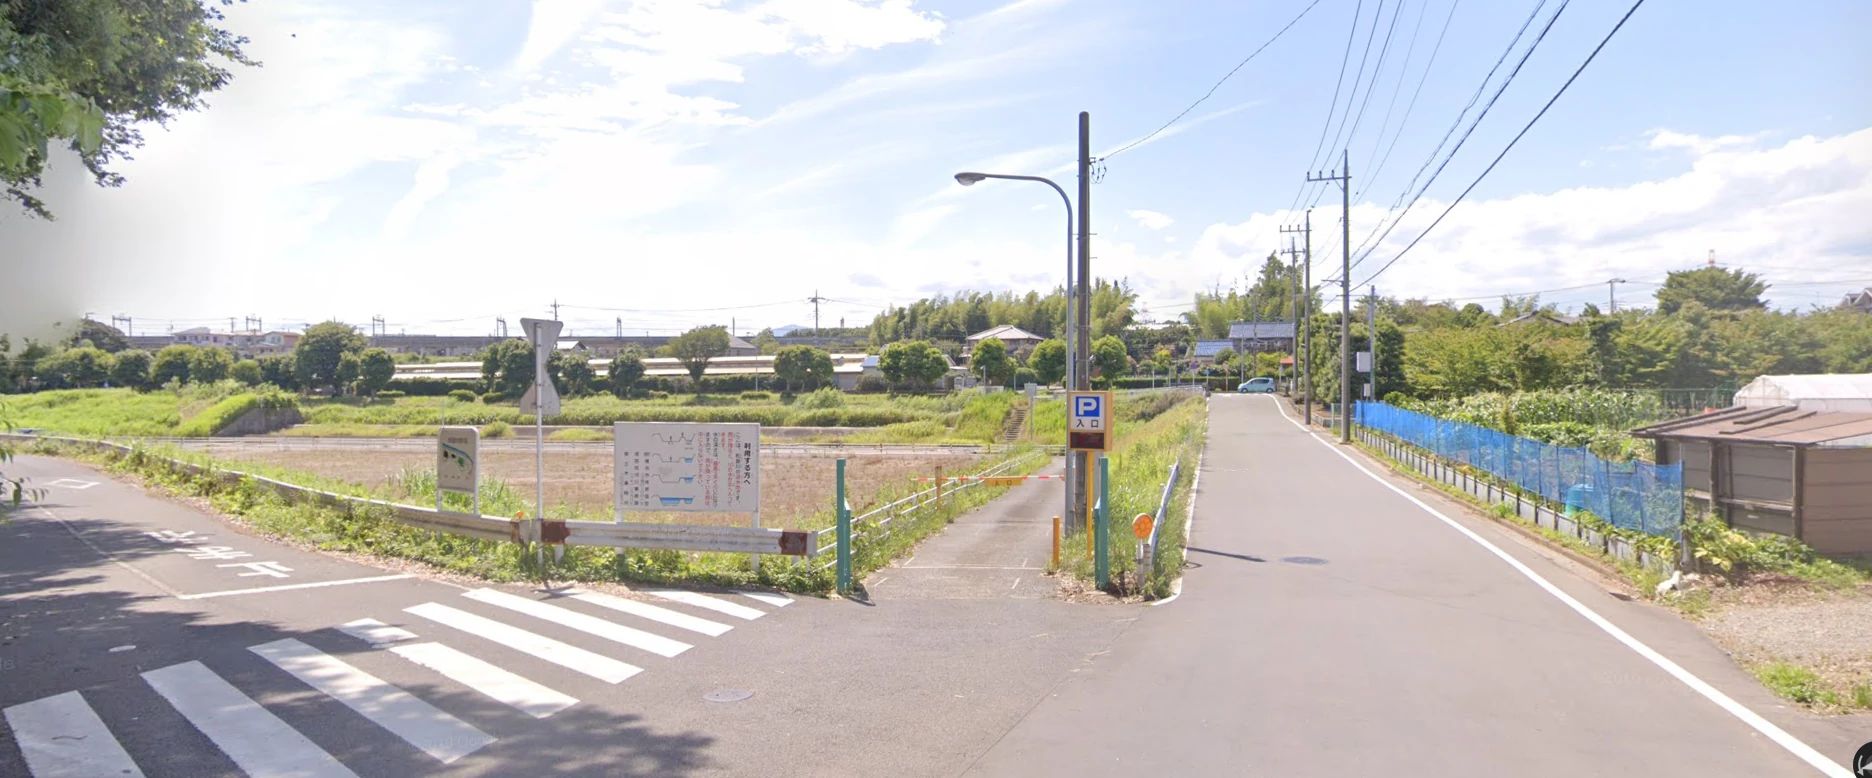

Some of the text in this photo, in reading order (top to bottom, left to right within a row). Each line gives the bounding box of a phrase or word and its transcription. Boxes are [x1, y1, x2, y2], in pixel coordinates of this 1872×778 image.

[1078, 398, 1097, 416] P
[1076, 418, 1099, 428] 入口
[743, 442, 752, 485] 利用する方へ
[143, 529, 295, 578] 止まれ
